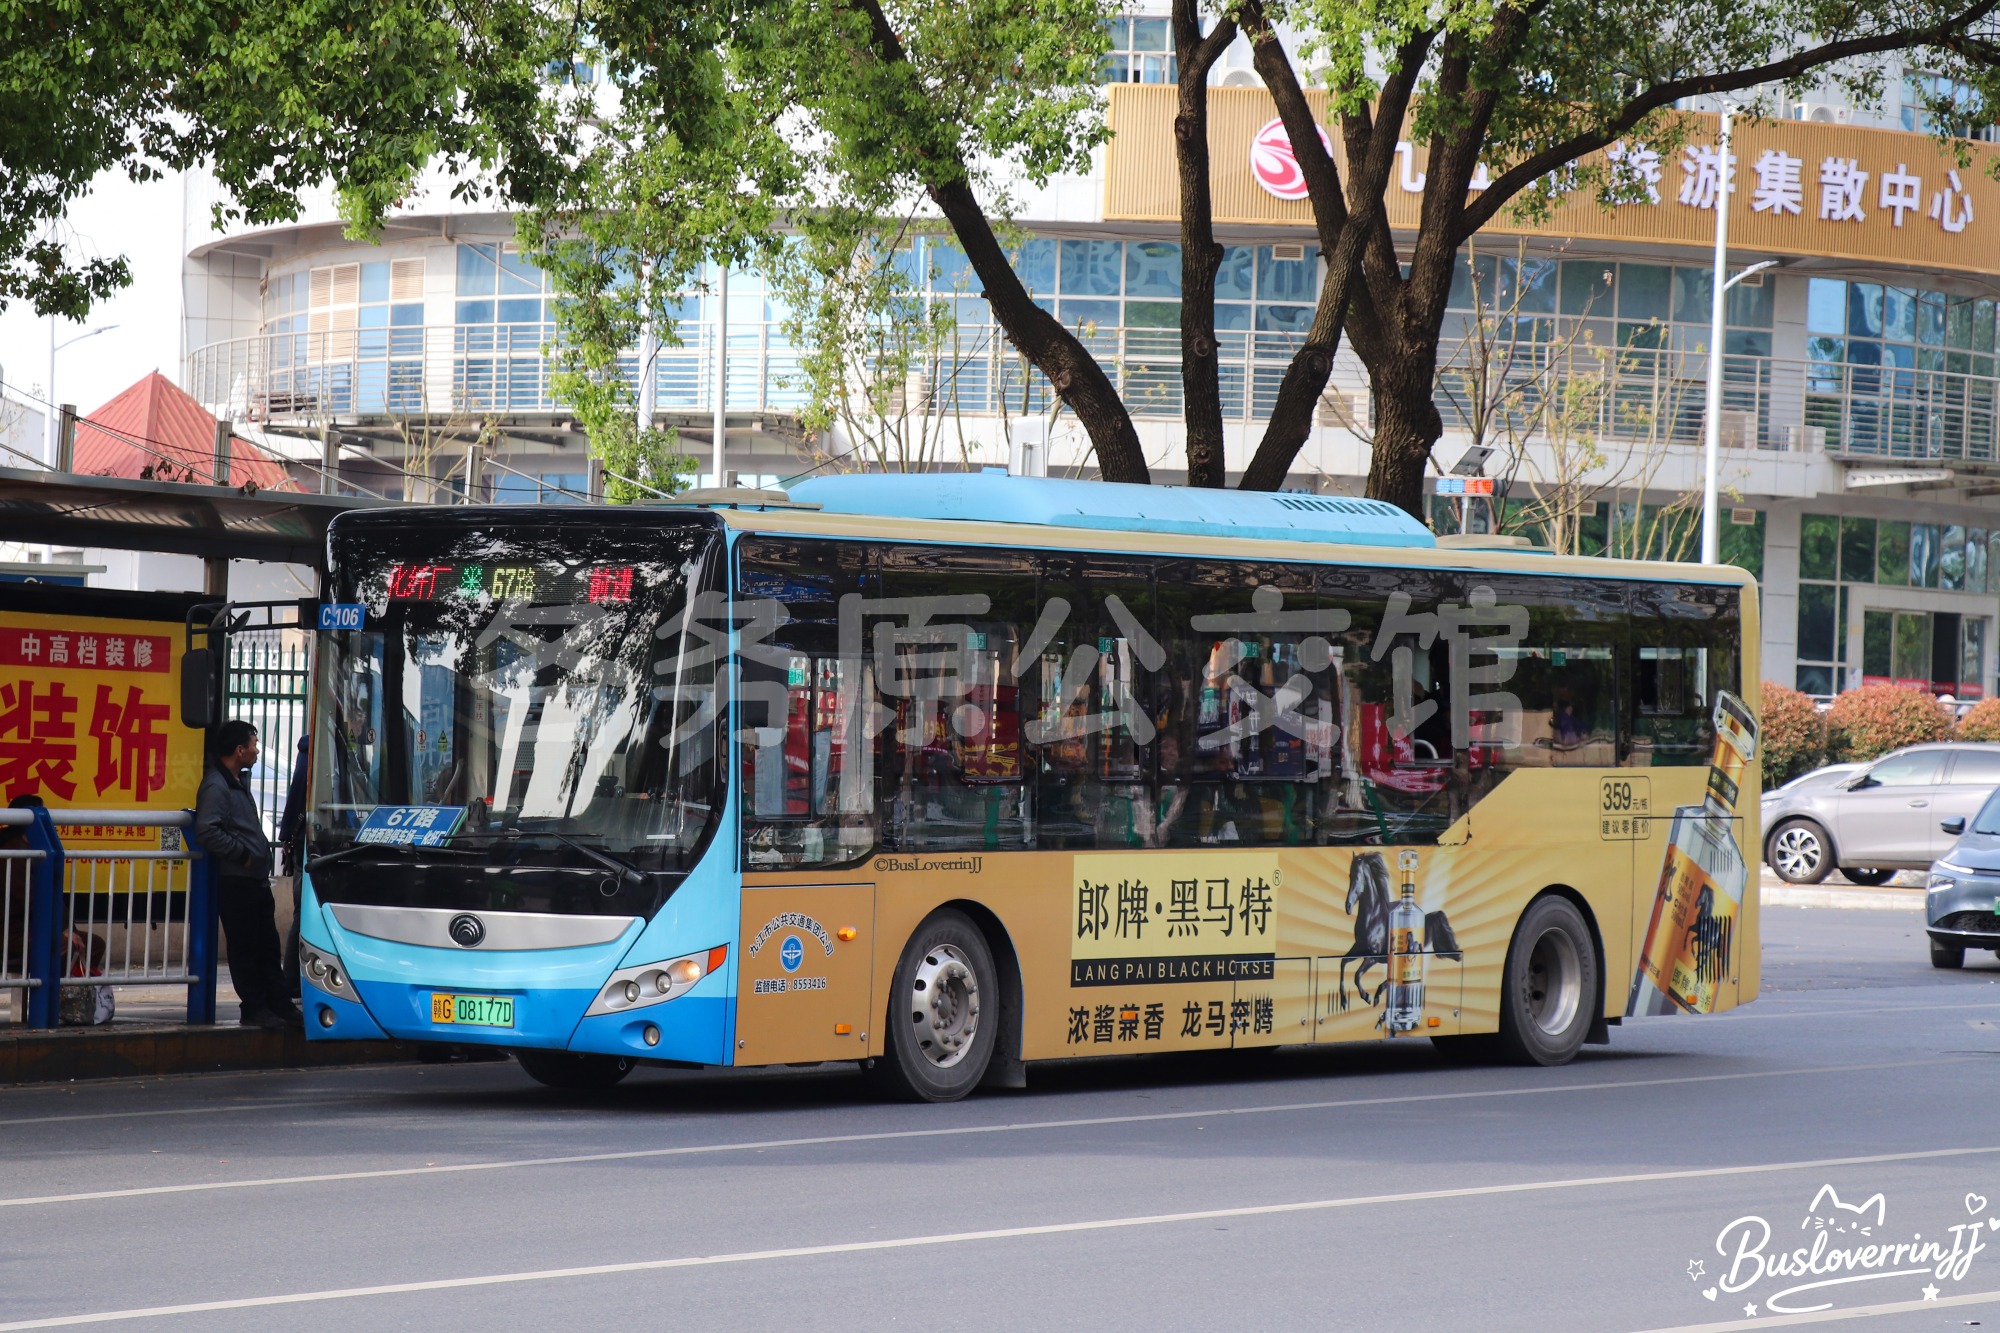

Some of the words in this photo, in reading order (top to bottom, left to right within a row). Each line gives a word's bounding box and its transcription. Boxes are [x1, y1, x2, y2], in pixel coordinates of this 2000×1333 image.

[1395, 141, 1974, 232] 旅游集散中心
[388, 565, 452, 600] 化纤厂
[491, 567, 536, 600] 67路
[589, 566, 634, 602] 前进
[334, 606, 360, 627] 106
[20, 633, 153, 667] 中高档装修
[0, 679, 171, 803] 装饰
[1603, 782, 1632, 811] 359
[387, 808, 440, 828] 67路
[1602, 819, 1649, 835] 建议零售价
[1076, 877, 1273, 940] 郎牌·黑马特
[748, 911, 835, 958] 九江市公共交通集团公司
[1075, 964, 1120, 981] LANG
[1125, 963, 1152, 979] PAI
[1158, 960, 1211, 977] BLACK
[1217, 958, 1271, 976] HORSE
[1181, 997, 1273, 1038] 龙马奔腾
